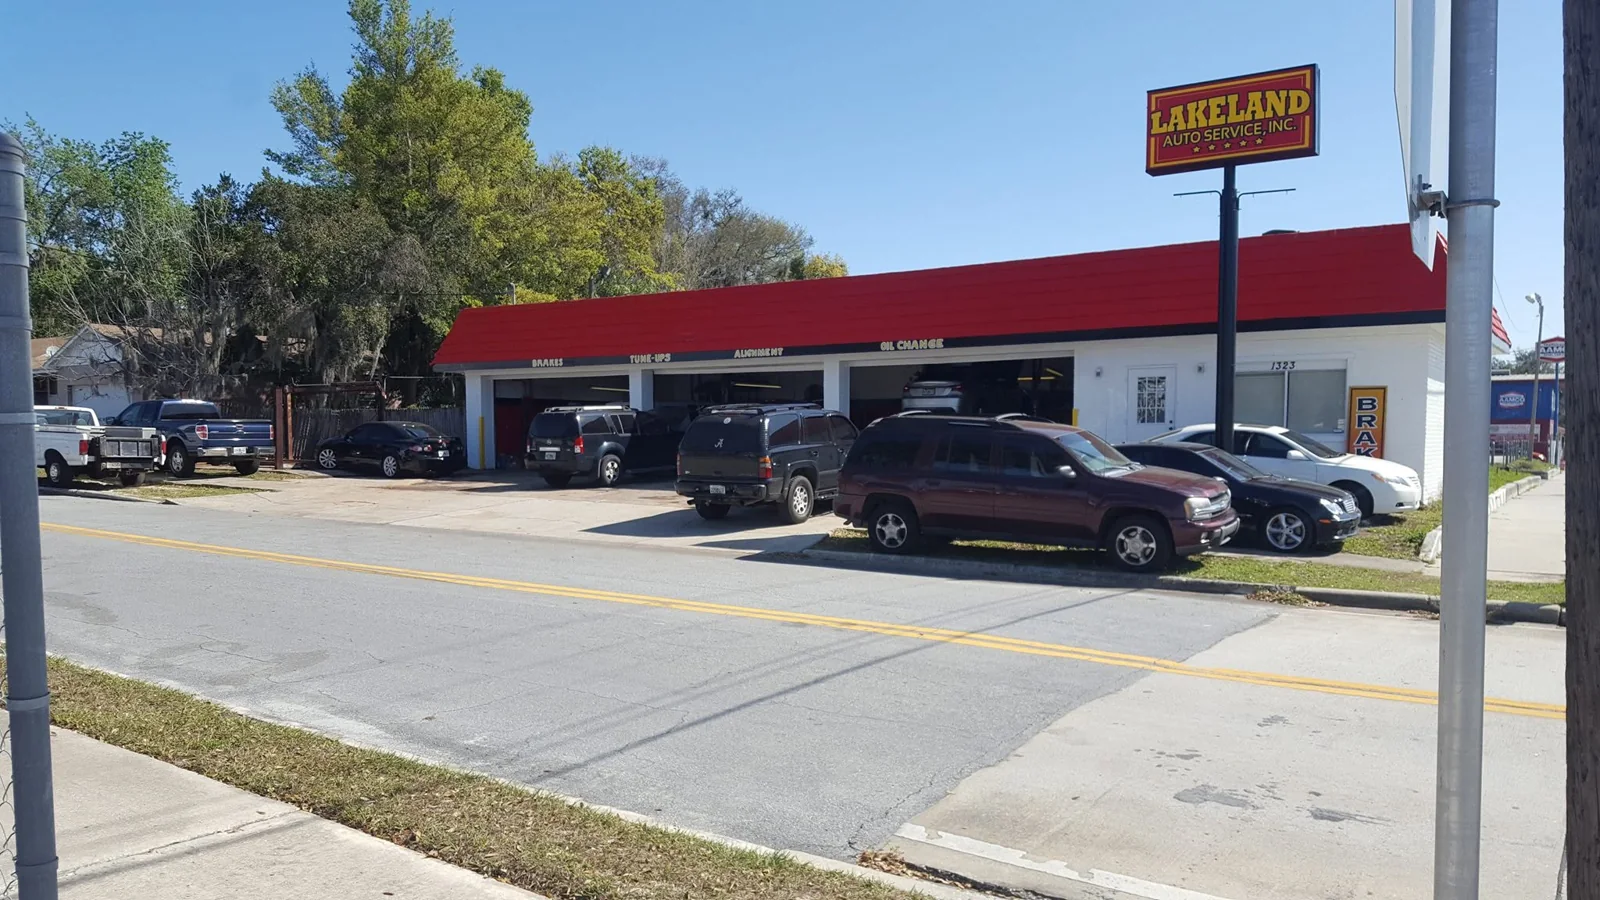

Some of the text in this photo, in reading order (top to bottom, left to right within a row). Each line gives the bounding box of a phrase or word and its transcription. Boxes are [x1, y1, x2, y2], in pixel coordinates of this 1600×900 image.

[1150, 89, 1311, 134] LAKELAND
[1162, 131, 1201, 148] AUTO
[1268, 118, 1297, 133] INC.
[881, 338, 944, 350] OIL CHANGE
[629, 353, 671, 364] TUNE-UPS
[734, 347, 784, 359] ALIGNMENT
[532, 358, 564, 368] BRAKES
[1271, 360, 1296, 370] 1323
[1499, 396, 1525, 404] AAMCO
